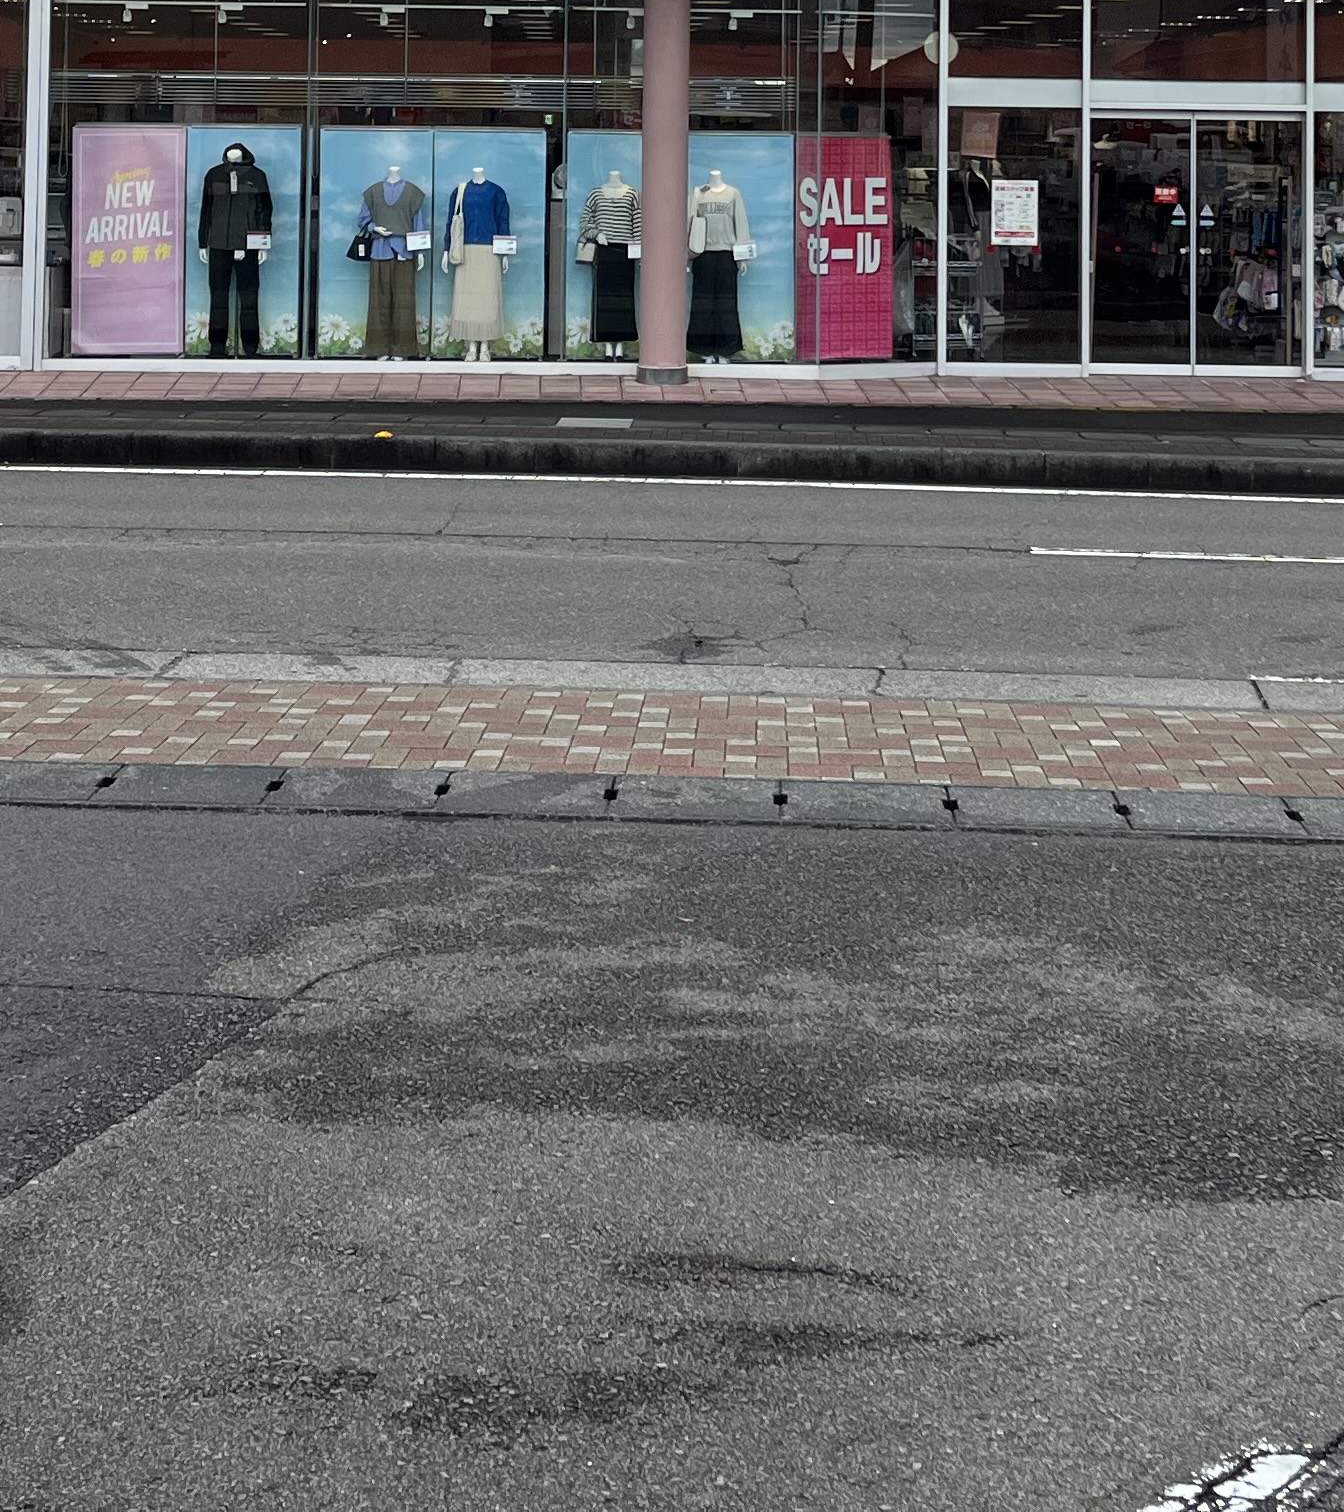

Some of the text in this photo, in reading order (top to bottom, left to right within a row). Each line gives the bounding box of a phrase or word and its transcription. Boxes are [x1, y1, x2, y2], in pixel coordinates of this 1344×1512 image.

[104, 179, 155, 210] NEW
[799, 177, 888, 227] SALE
[85, 209, 173, 244] ARRIVAL
[87, 243, 172, 268] 春の新作
[807, 232, 881, 275] セール
